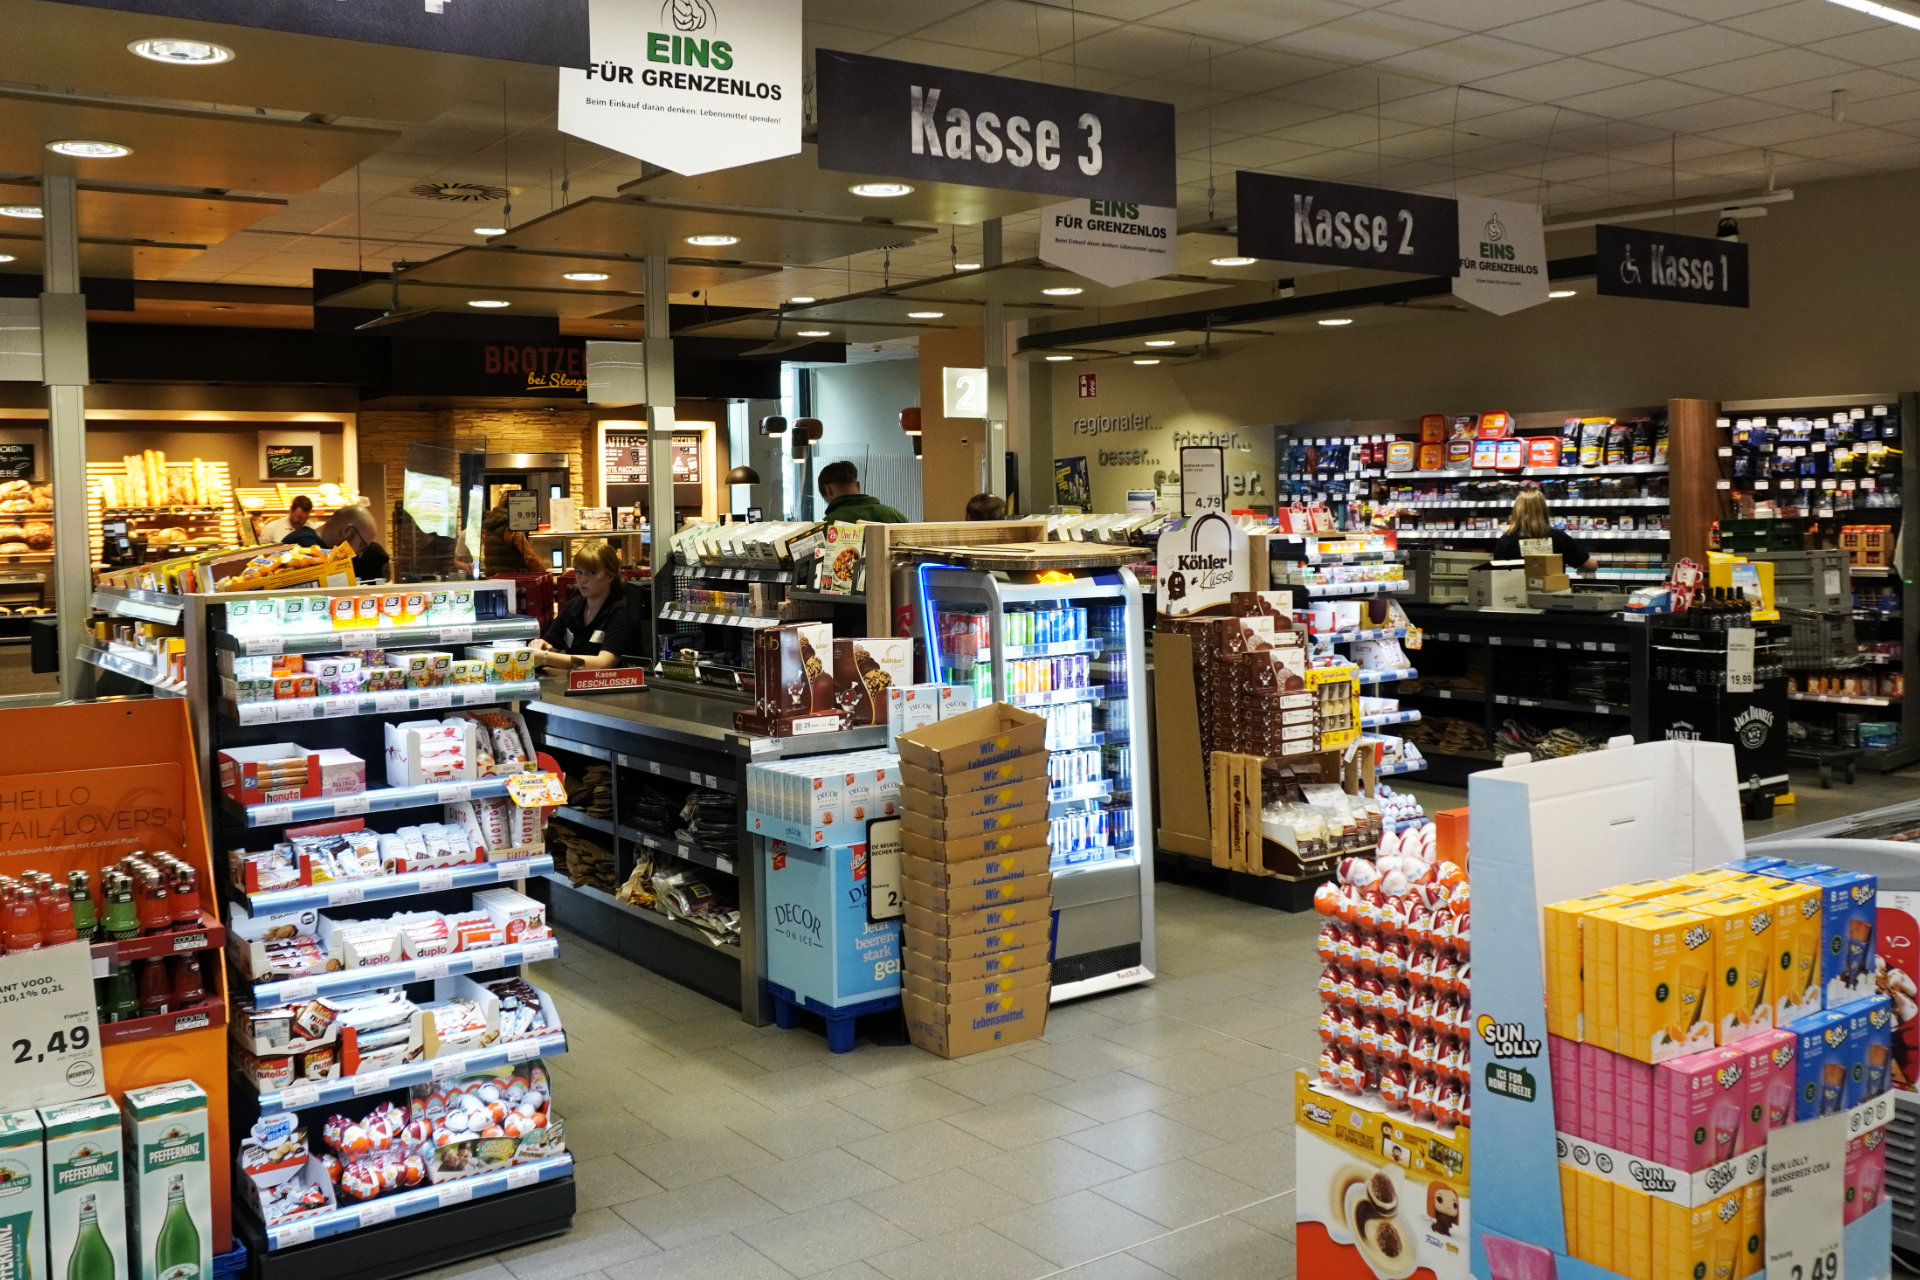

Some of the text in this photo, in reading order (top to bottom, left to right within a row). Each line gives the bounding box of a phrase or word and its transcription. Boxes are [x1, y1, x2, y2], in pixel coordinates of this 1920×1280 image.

[647, 31, 734, 71] EINS
[585, 60, 783, 101] FÜR GRENZENLOS
[585, 97, 781, 125] Beim Einkauf daran denken: Lebensmittel spenden!
[910, 84, 1103, 177] Kasse 3
[1089, 198, 1140, 220] EINS
[1055, 214, 1167, 239] FÜR GRENZENLOS
[1293, 193, 1415, 256] Kasse 2
[1480, 242, 1516, 261] EINS
[1459, 257, 1539, 275] FÜR GRENZENLOS
[1650, 243, 1729, 292] Kasse 1
[527, 371, 546, 385] bei
[955, 376, 977, 411] 2
[517, 511, 536, 520] 9,99
[1177, 553, 1228, 571] Köhler
[1199, 566, 1235, 591] Küsse
[595, 671, 618, 679] Kasse
[1731, 674, 1752, 686] 19,99
[576, 677, 637, 688] GESCHLOSSEN
[1734, 709, 1750, 732] JACK
[1665, 729, 1702, 741] MAKE IT
[980, 742, 995, 755] Wir
[984, 770, 998, 782] Wir
[0, 785, 90, 811] HELLO
[266, 790, 300, 803] hanuta
[984, 794, 998, 806] Wir
[983, 818, 997, 830] Wir
[91, 838, 120, 848] Cocktail
[984, 840, 998, 851] Wir
[986, 862, 1000, 874] Wir
[985, 889, 999, 900] Wir
[774, 903, 822, 941] DECOR
[986, 913, 1000, 925] Wir
[1725, 919, 1732, 931] 8
[173, 933, 207, 945] COCKTAIL
[785, 930, 797, 940] ON
[1653, 934, 1661, 946] 8
[1684, 924, 1705, 945] SUN
[173, 940, 208, 952] PLANT
[855, 933, 897, 950] beeren-
[986, 937, 1000, 948] Wir
[417, 945, 448, 958] duplo
[863, 946, 892, 962] stark
[359, 954, 391, 967] duplo
[986, 960, 999, 971] Wir
[1116, 968, 1141, 980] Red Bull
[41, 984, 64, 995] 0,2L
[985, 983, 999, 994] Wir
[985, 1002, 999, 1013] Wir
[63, 1010, 89, 1021] Flasche
[175, 1012, 209, 1024] COCKTAIL
[175, 1018, 210, 1031] PLANT
[1484, 1023, 1524, 1043] SUN
[12, 1025, 90, 1064] 2,49
[1494, 1039, 1542, 1058] LOLLY
[1803, 1037, 1810, 1049] 8
[1750, 1056, 1757, 1068] 8
[67, 1068, 93, 1079] MEHRWEG
[257, 1070, 288, 1079] nutella
[1496, 1068, 1523, 1086] ICE FOR
[1487, 1076, 1532, 1099] HOME FREEZE
[1692, 1077, 1699, 1090] 8
[149, 1142, 200, 1165] PFEFFERMINZ
[1770, 1155, 1809, 1174] SUN LOLLY
[58, 1161, 114, 1184] PFEFFERMINZ
[1634, 1168, 1664, 1182] SUN
[1770, 1162, 1831, 1185] WASSEREIS COLA
[1641, 1179, 1677, 1192] LOLLY
[1770, 1185, 1794, 1198] 480ML
